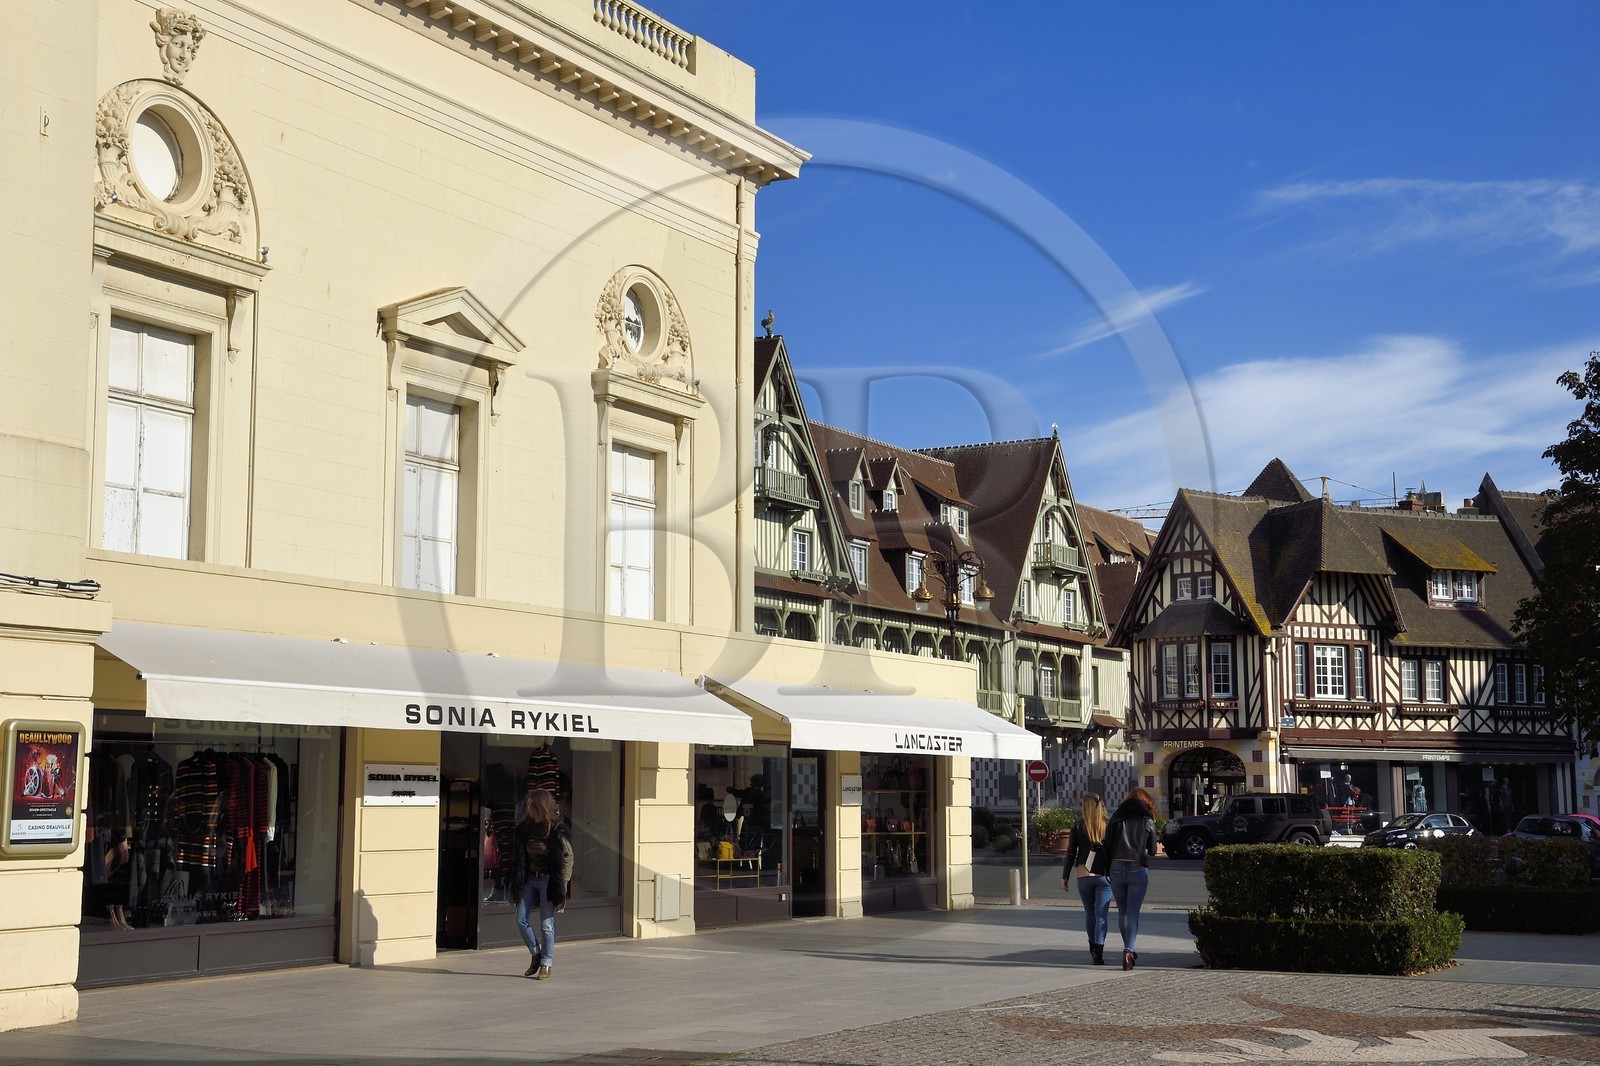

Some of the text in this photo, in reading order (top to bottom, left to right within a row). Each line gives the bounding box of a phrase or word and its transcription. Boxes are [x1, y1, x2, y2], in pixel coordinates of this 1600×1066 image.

[405, 703, 600, 734] SONIA RYKIEL
[19, 732, 72, 744] DEAULLYWOOD
[894, 733, 963, 752] LANCASTER
[1163, 740, 1204, 748] PRINTEMPS
[367, 773, 439, 782] SONIA RYKIEL
[205, 891, 246, 902] RYKIEL
